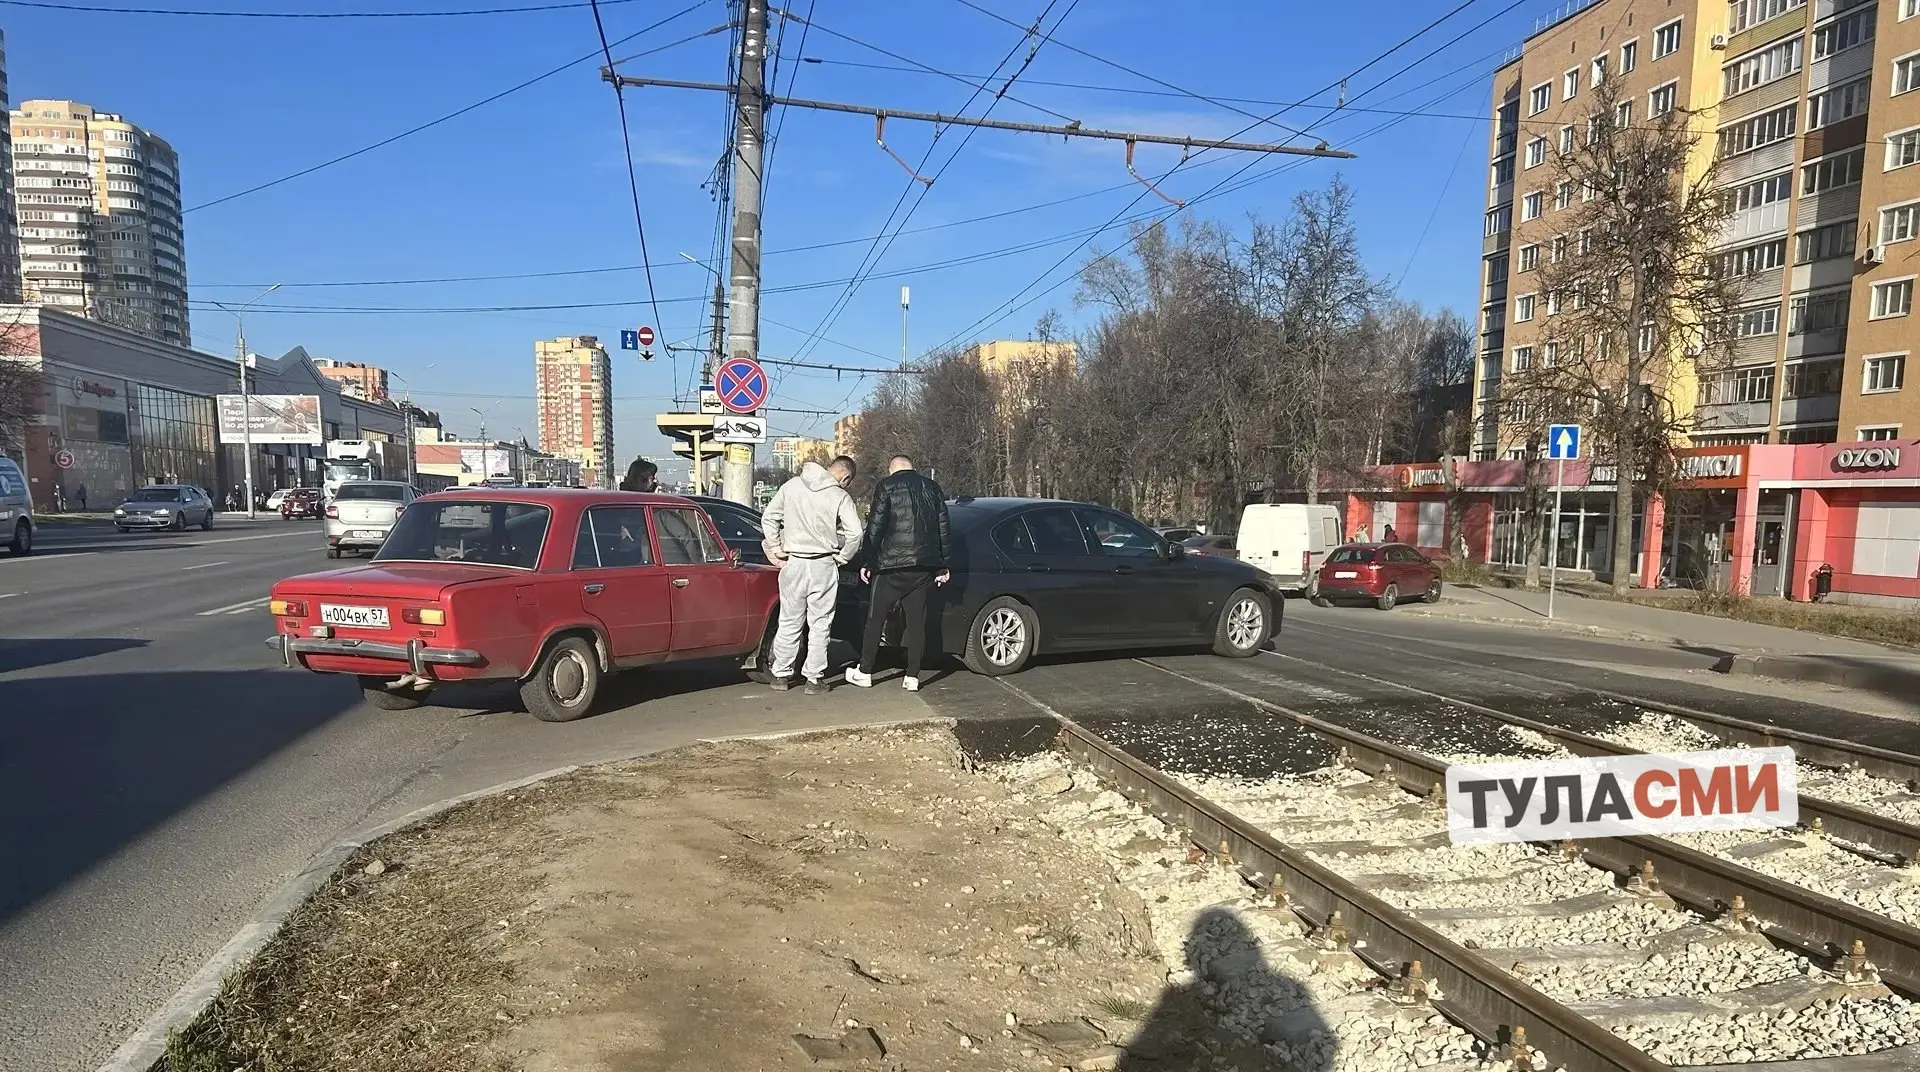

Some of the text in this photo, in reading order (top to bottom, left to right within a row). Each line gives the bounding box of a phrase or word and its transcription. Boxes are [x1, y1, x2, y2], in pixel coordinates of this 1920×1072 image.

[1838, 448, 1900, 467] OZON
[325, 608, 383, 623] Н004ВК 57
